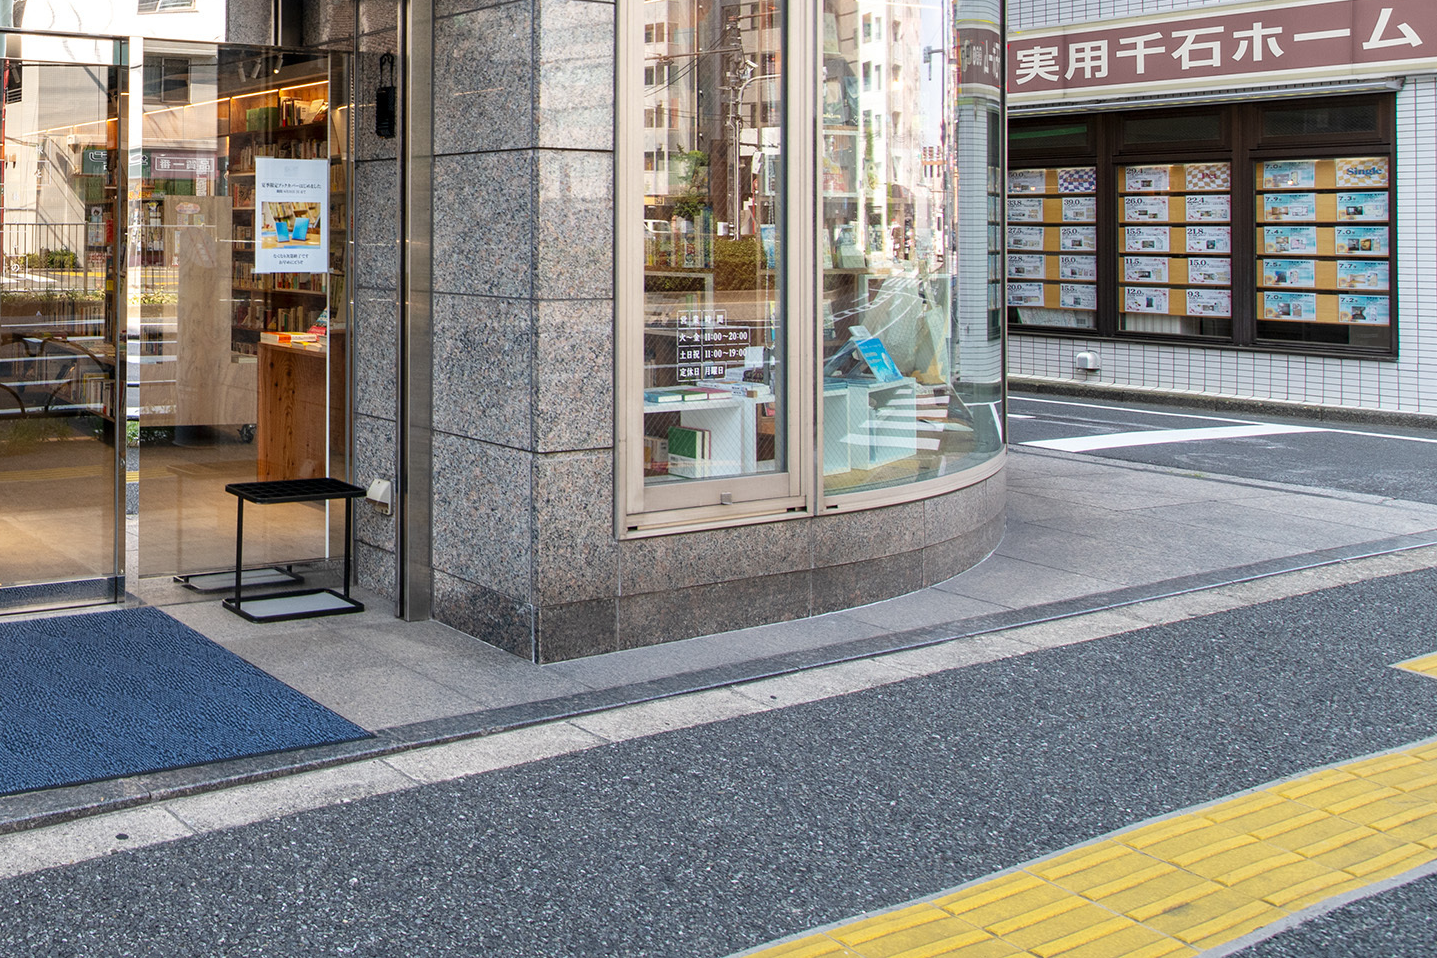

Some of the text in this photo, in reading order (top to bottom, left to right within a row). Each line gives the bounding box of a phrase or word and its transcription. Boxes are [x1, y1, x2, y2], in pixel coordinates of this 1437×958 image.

[1015, 7, 1423, 85] 実用千石ホーム
[1346, 167, 1382, 176] Single
[679, 349, 700, 359] 土日祝
[679, 366, 724, 377] 定休日 月曜日
